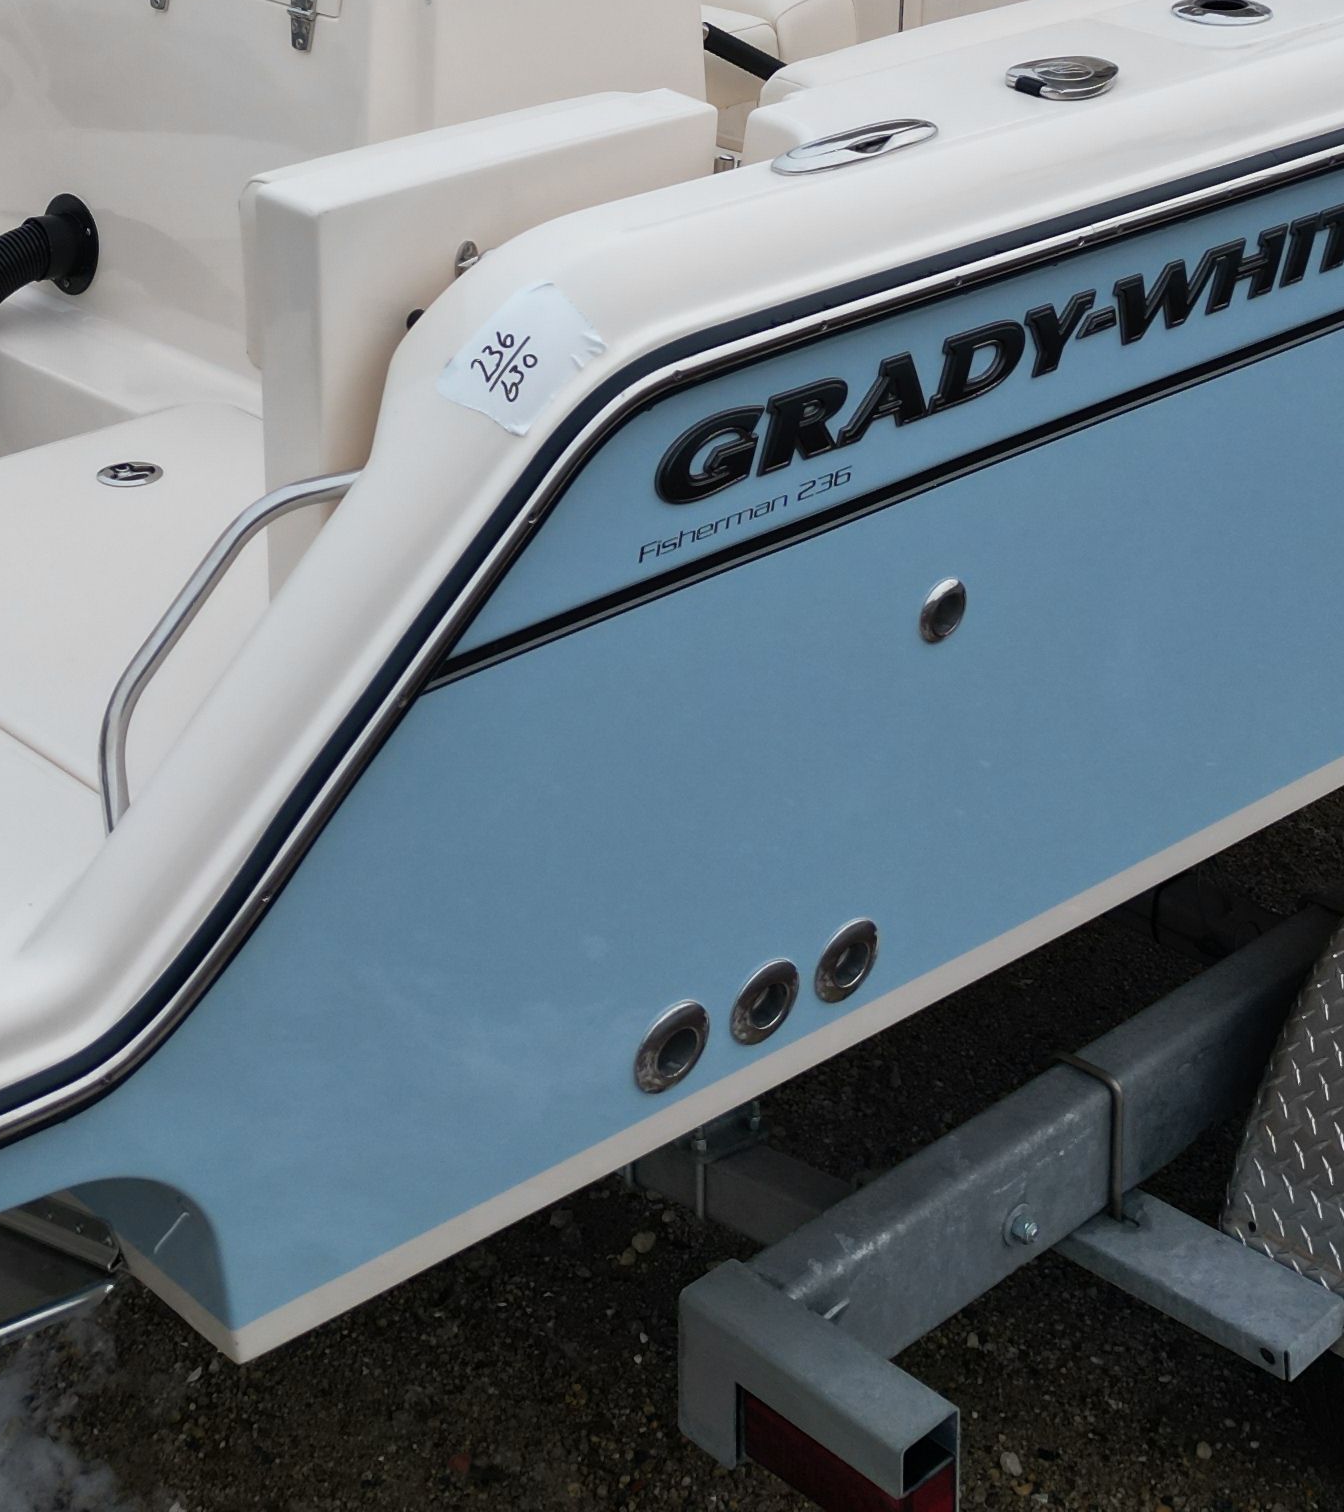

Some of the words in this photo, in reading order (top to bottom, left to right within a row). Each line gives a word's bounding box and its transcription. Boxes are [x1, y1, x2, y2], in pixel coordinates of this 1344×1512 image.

[470, 331, 515, 383] 236
[638, 494, 789, 564] Fisherman
[797, 465, 853, 502] 236
